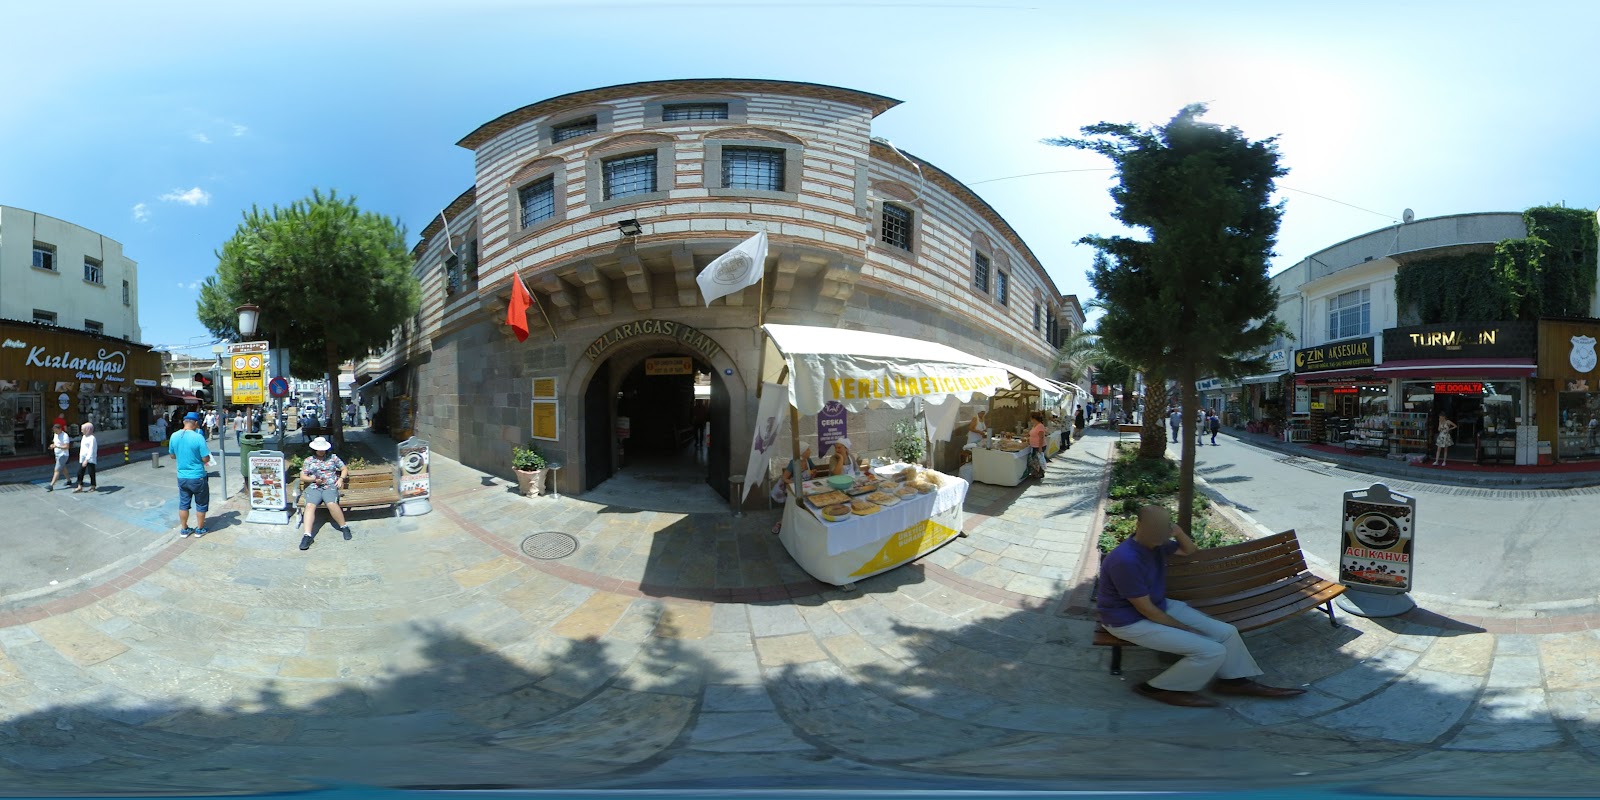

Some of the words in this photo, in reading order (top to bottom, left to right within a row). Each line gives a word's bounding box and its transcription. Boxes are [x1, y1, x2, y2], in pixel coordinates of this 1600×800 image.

[682, 326, 721, 359] HANI
[1307, 347, 1325, 363] ZİN
[1328, 342, 1369, 360] AKSESUAR
[828, 376, 892, 400] YERLİ
[821, 418, 844, 427] ÇEŞKA
[1346, 547, 1366, 557] ACI
[1368, 550, 1409, 563] KAHVE
